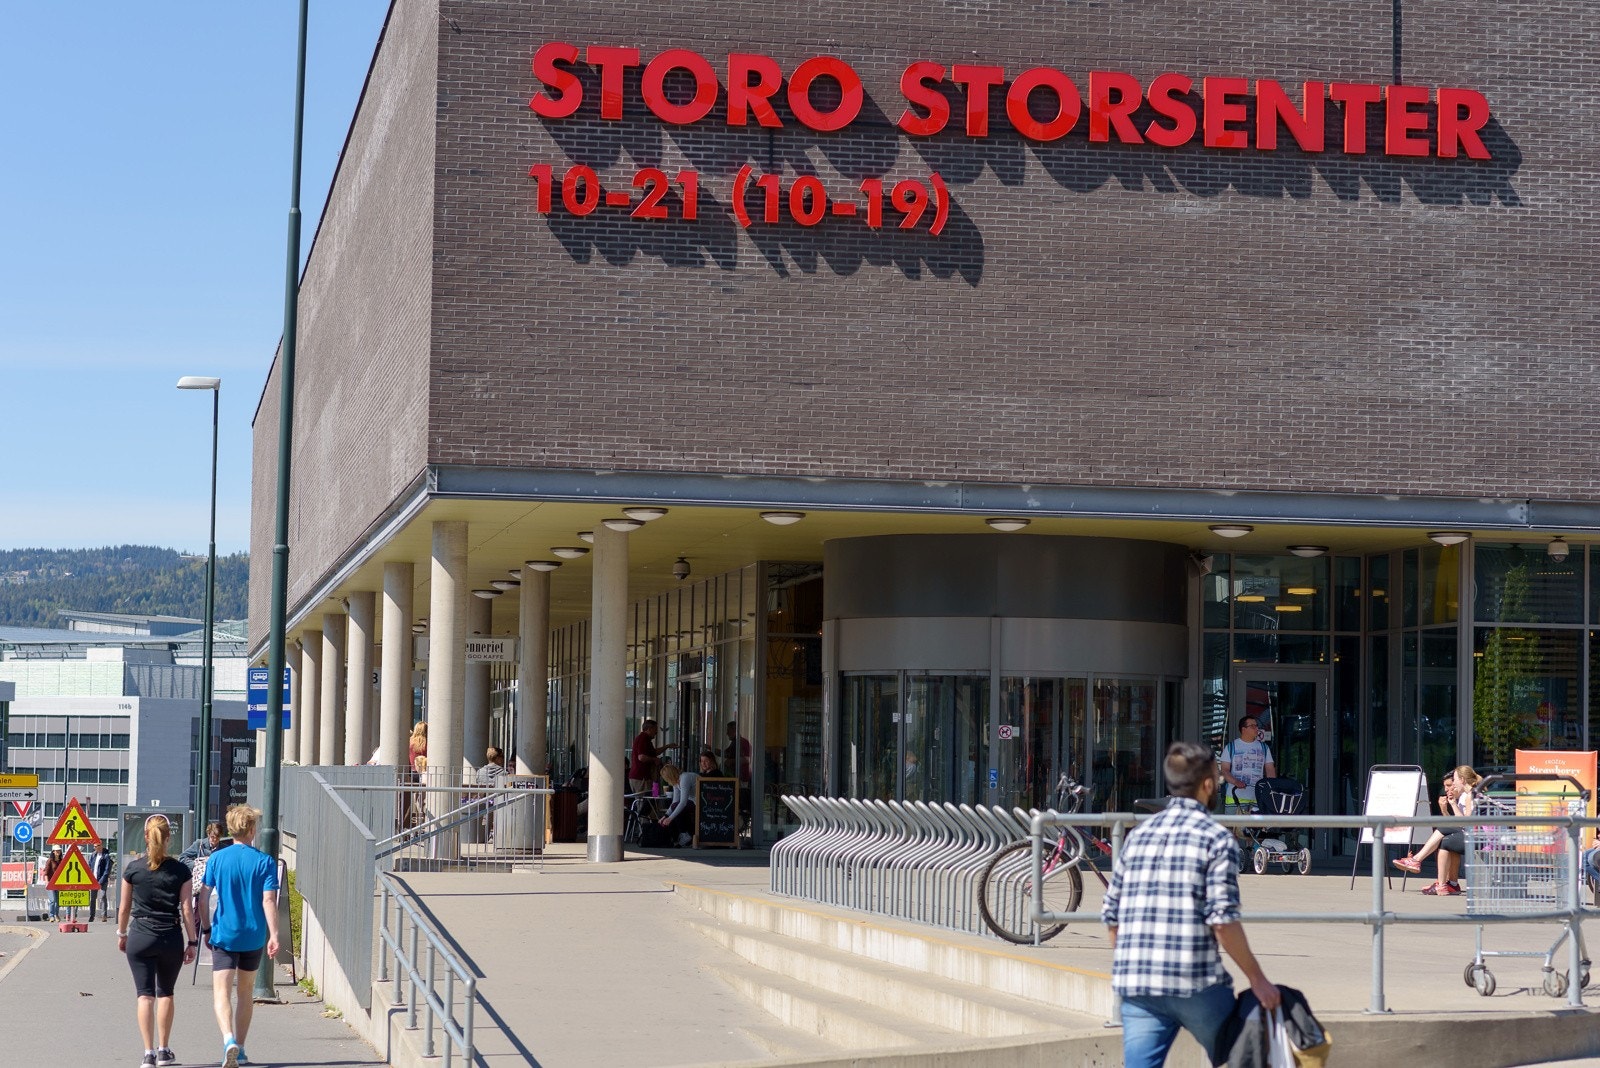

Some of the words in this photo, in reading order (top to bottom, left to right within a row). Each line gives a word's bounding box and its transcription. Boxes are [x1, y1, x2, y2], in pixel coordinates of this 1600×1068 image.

[528, 42, 864, 132] STORO
[897, 61, 1492, 160] STORSENTER
[528, 164, 699, 220] 10-21
[732, 164, 949, 236] (10-19)
[234, 748, 249, 763] JOB
[59, 891, 87, 899] Anleggs-
